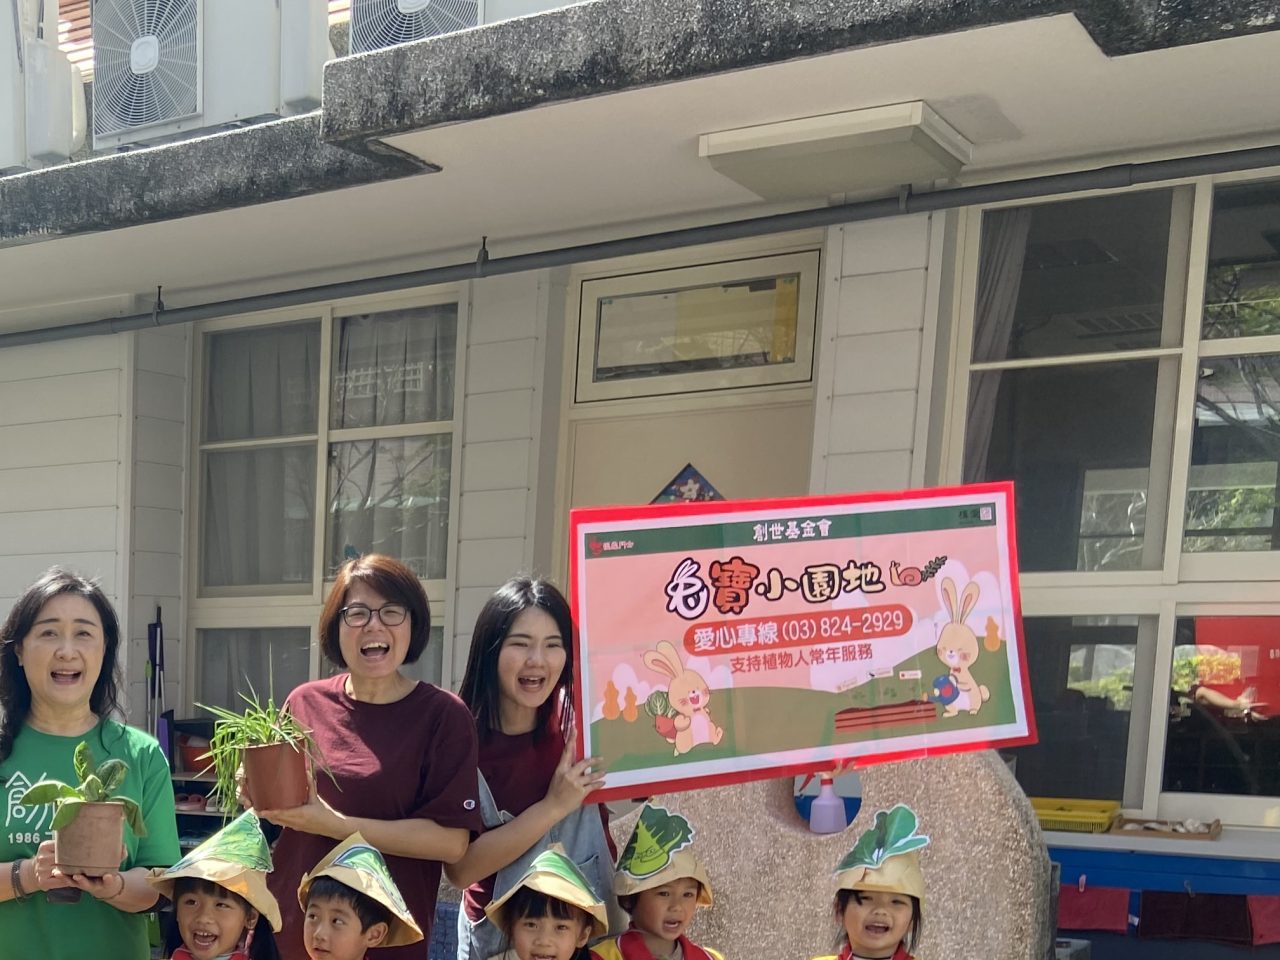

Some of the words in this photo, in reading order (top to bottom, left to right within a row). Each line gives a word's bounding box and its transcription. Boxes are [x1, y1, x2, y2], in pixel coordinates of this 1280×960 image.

[753, 518, 832, 542] 創世基金會
[694, 621, 778, 651] 愛心專線
[782, 619, 817, 645] (03)
[820, 611, 903, 635] 824-2929
[730, 646, 873, 675] 支持植物人常年服務
[8, 832, 41, 844] 1986
